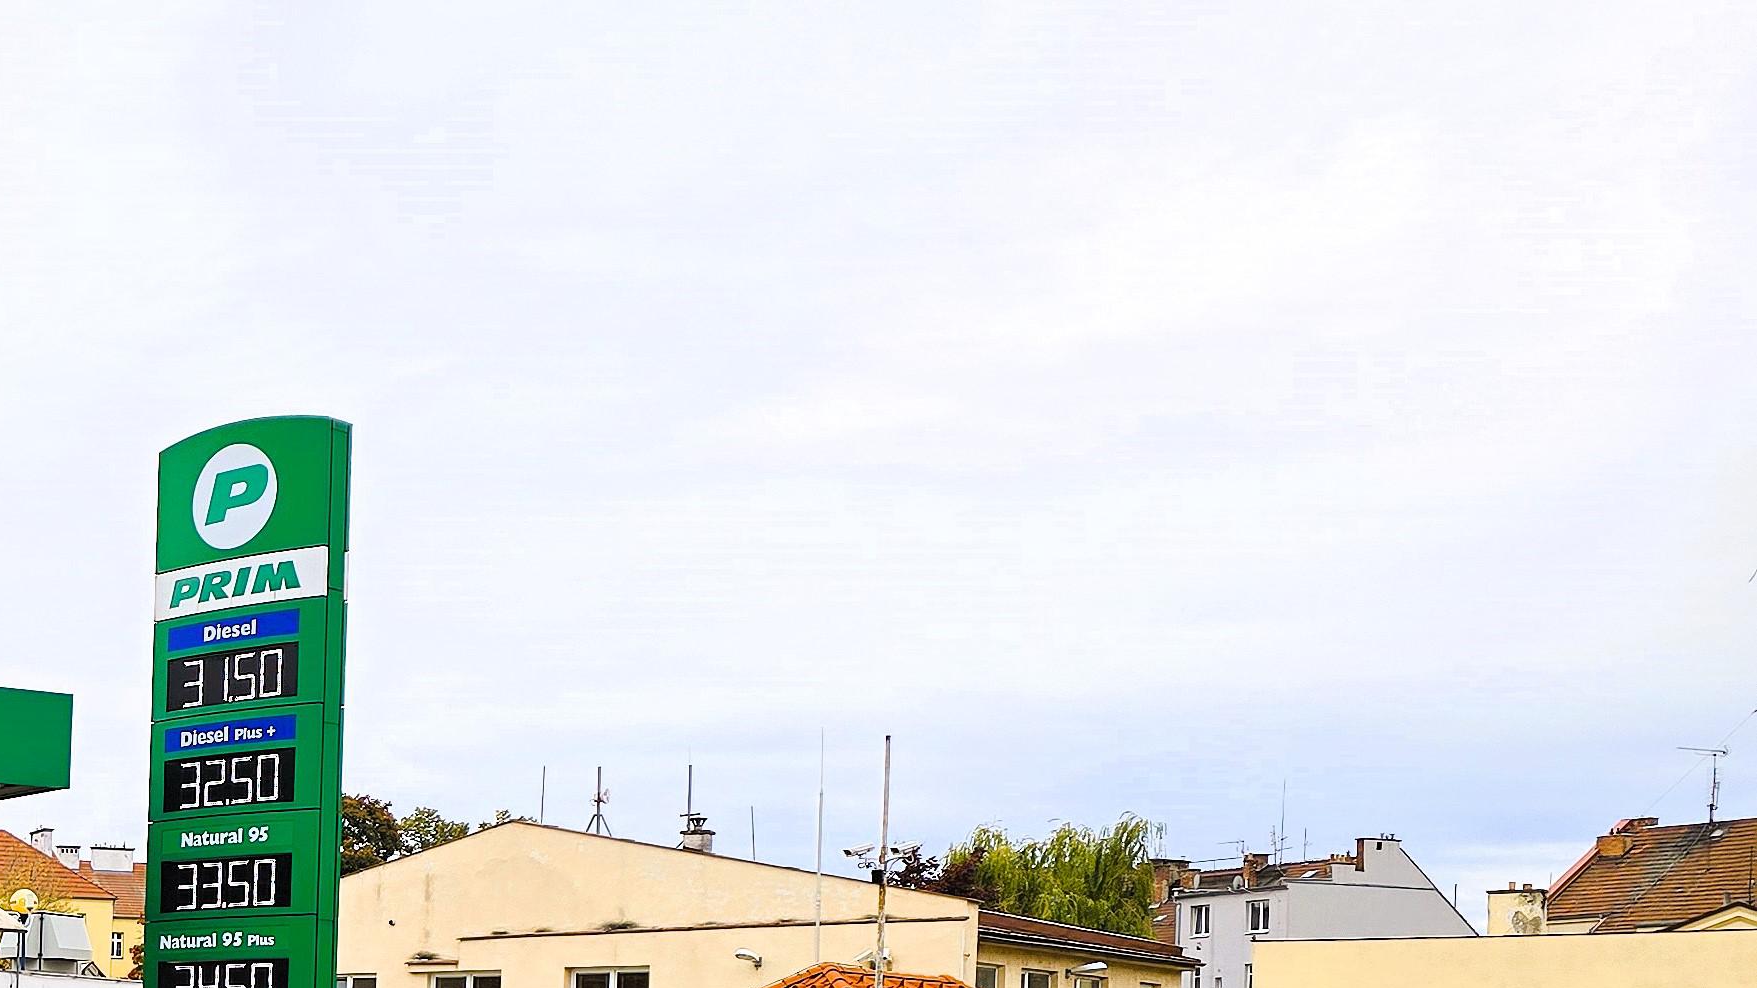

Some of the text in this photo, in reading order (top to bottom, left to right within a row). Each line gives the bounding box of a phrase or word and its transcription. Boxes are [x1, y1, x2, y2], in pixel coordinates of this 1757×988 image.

[204, 463, 269, 527] P
[169, 560, 302, 609] PRIM
[203, 618, 257, 642] Diesel
[180, 726, 229, 748] Diesel
[234, 727, 263, 741] Plus
[180, 826, 269, 848] Natural 95
[159, 931, 275, 950] Natural 95 Plus
